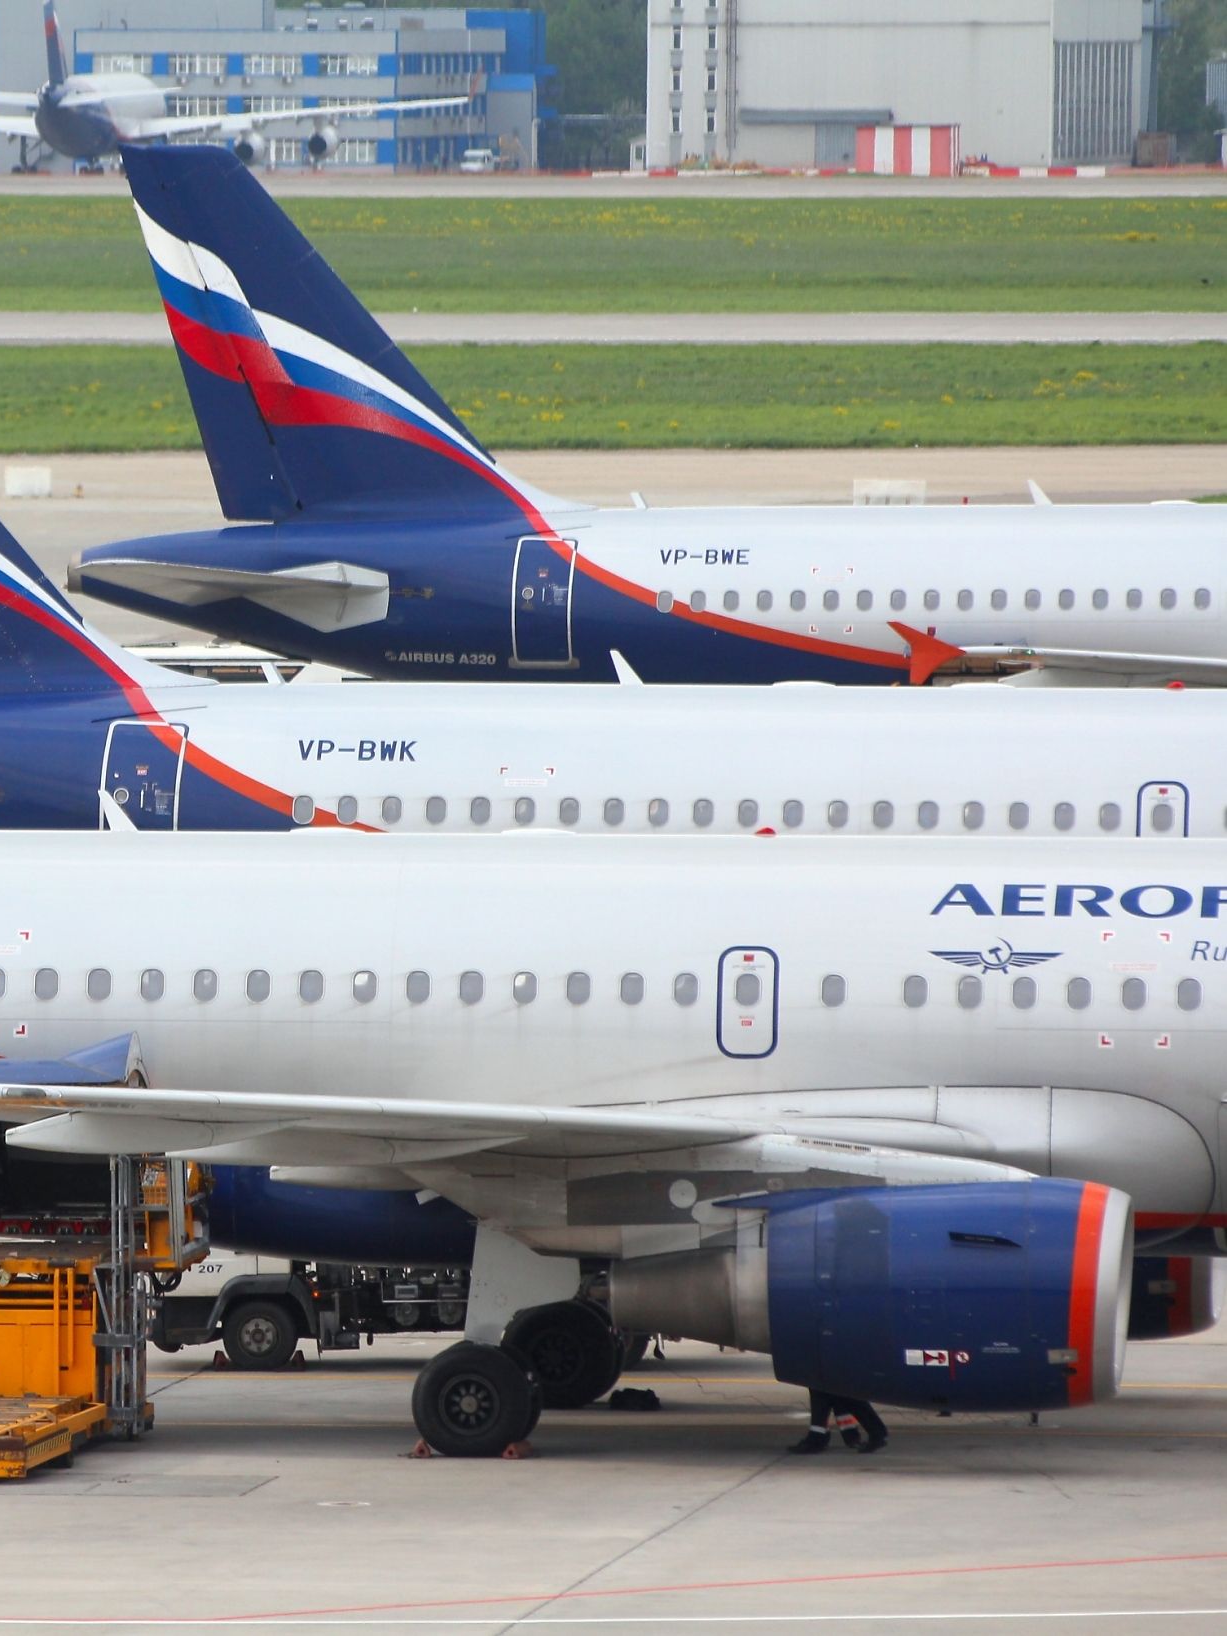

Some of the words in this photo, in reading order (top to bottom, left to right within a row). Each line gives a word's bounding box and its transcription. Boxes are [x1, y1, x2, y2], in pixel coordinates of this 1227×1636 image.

[660, 549, 750, 565] VP-BWE
[398, 652, 455, 665] AIRBUS
[458, 652, 496, 665] A320
[298, 739, 417, 762] VP-BWK
[929, 883, 1227, 919] AEROF
[1190, 940, 1227, 962] Ru
[198, 1264, 223, 1274] 207
